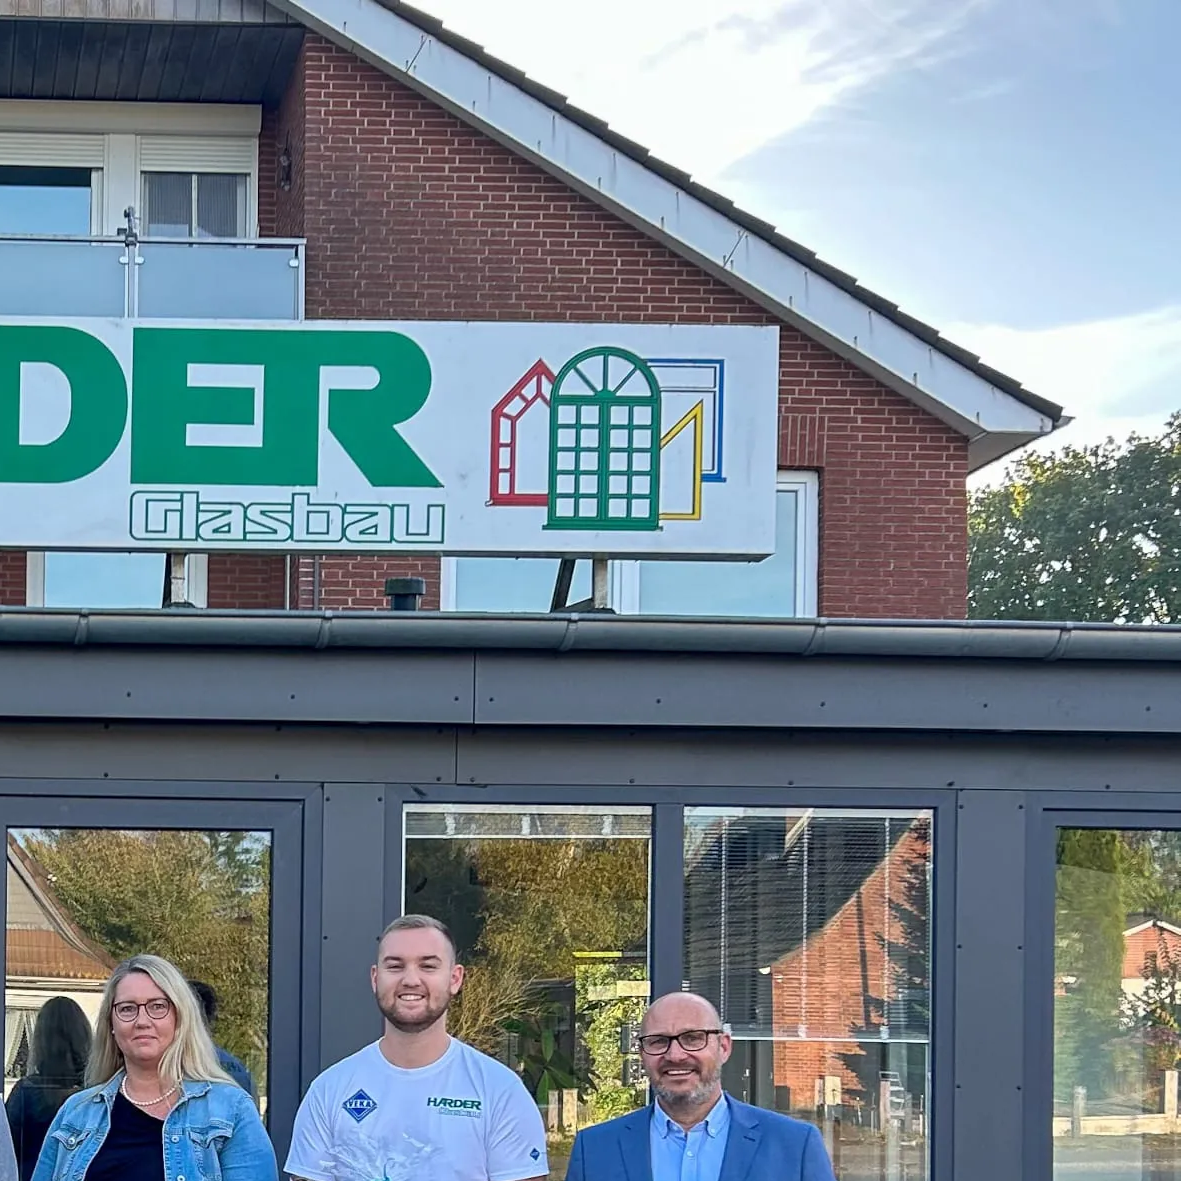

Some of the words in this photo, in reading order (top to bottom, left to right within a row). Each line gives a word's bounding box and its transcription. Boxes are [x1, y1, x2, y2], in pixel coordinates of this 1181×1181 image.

[130, 490, 444, 544] Glasbau
[348, 1100, 372, 1108] VEKA
[427, 1097, 482, 1110] HARDER
